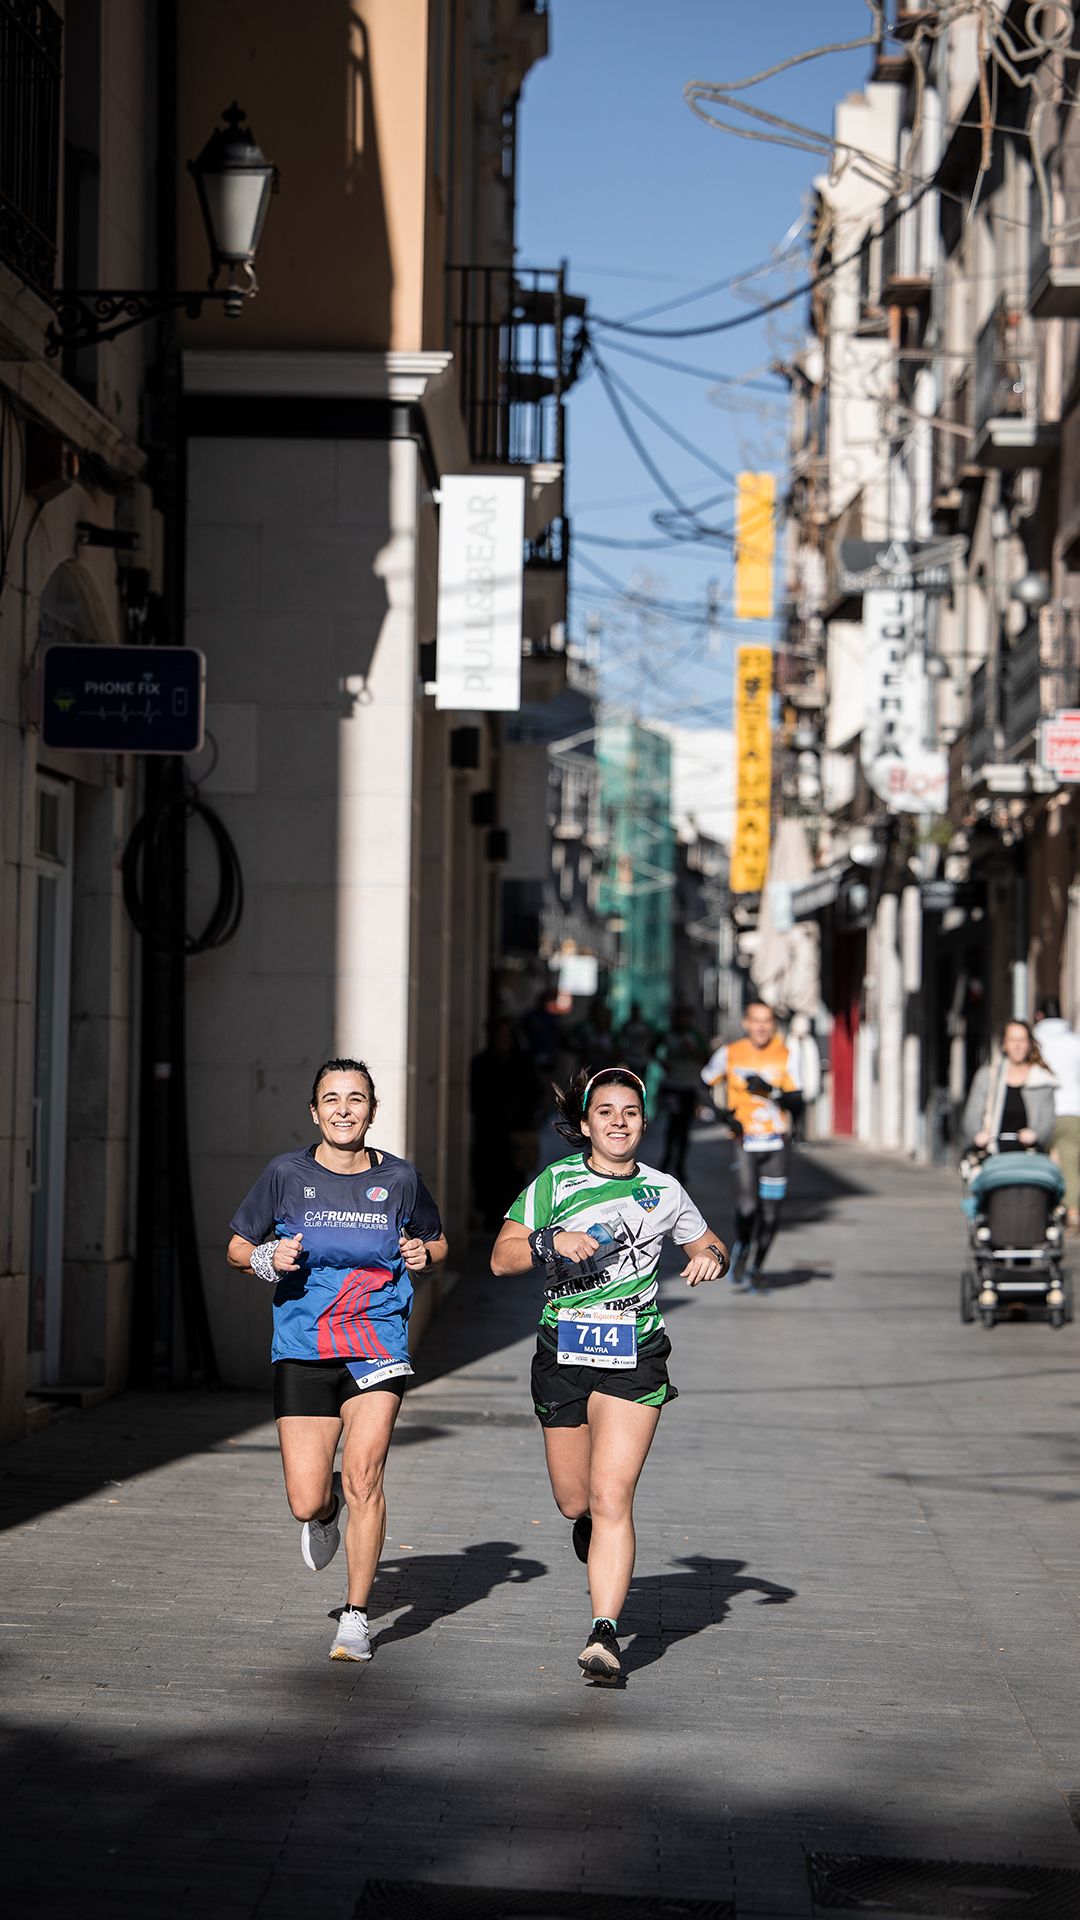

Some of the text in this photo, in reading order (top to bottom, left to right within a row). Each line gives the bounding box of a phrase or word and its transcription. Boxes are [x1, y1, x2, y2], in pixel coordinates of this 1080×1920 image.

[463, 494, 497, 692] PULL&BEAR
[84, 681, 135, 696] PHONE
[304, 1210, 388, 1224] CAFRUNNERS
[322, 1221, 358, 1229] ATLETISME
[358, 1222, 389, 1231] FIGUERES
[576, 1324, 619, 1347] 714
[583, 1345, 609, 1354] MAYRA
